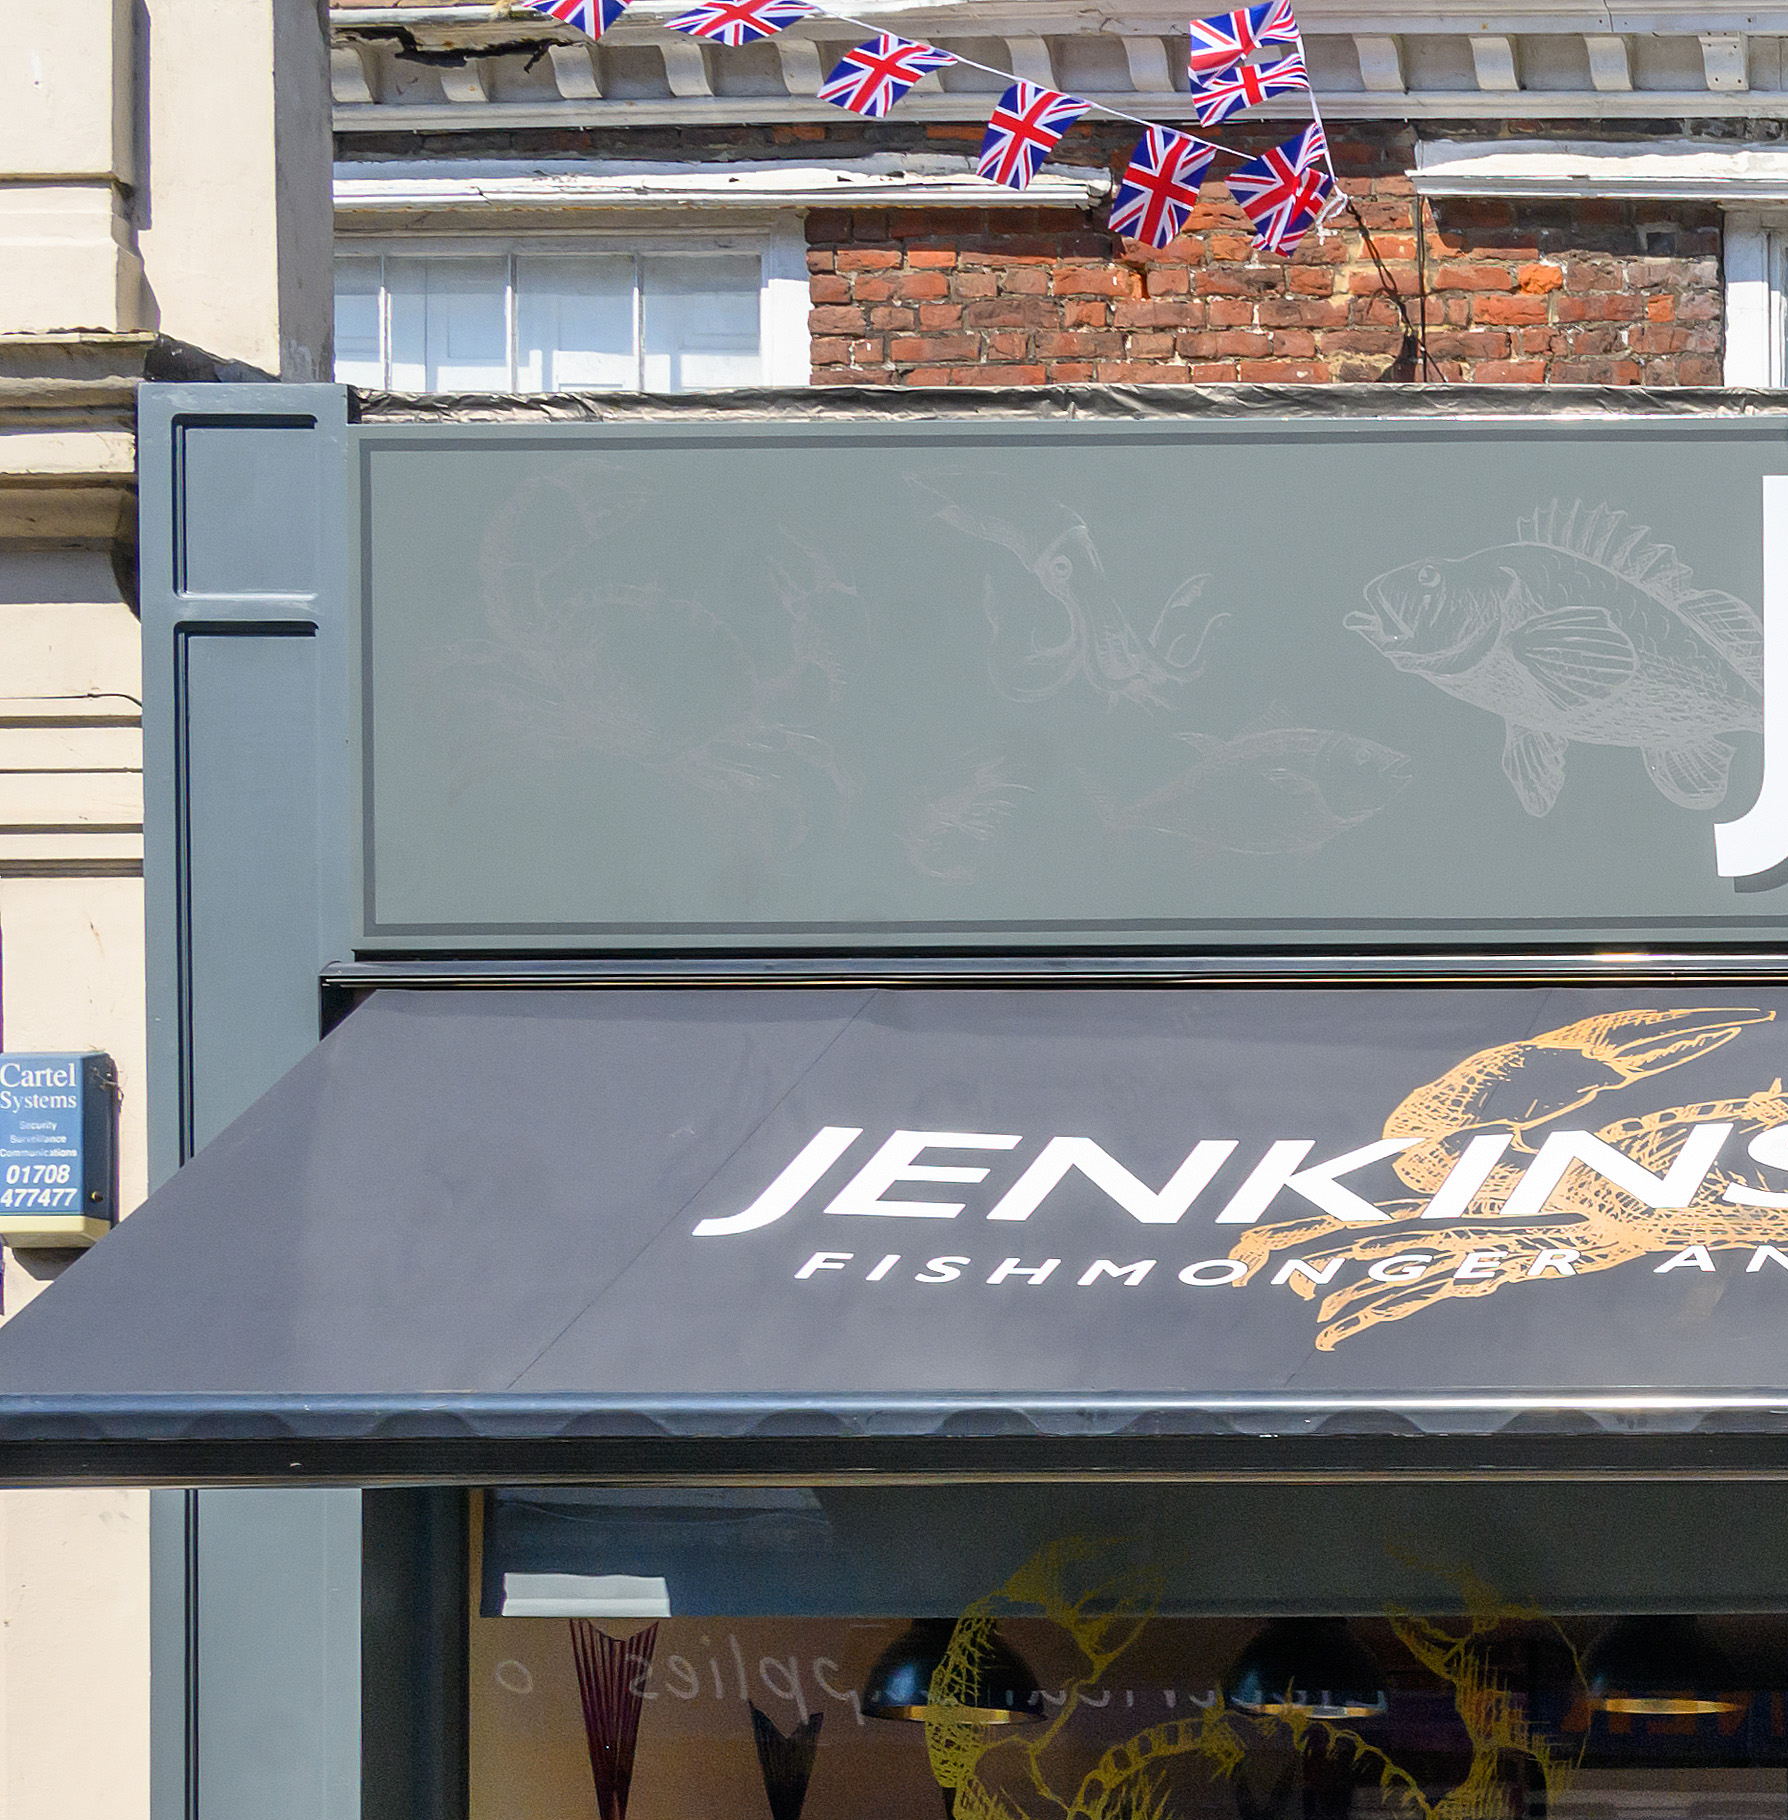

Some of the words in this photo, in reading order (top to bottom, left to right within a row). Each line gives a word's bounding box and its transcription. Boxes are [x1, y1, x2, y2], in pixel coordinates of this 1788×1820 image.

[0, 1062, 77, 1088] Cartel
[0, 1090, 78, 1113] Systems
[6, 1164, 71, 1185] 01708
[0, 1188, 78, 1208] 477477
[794, 1247, 1581, 1289] FISHMONGER
